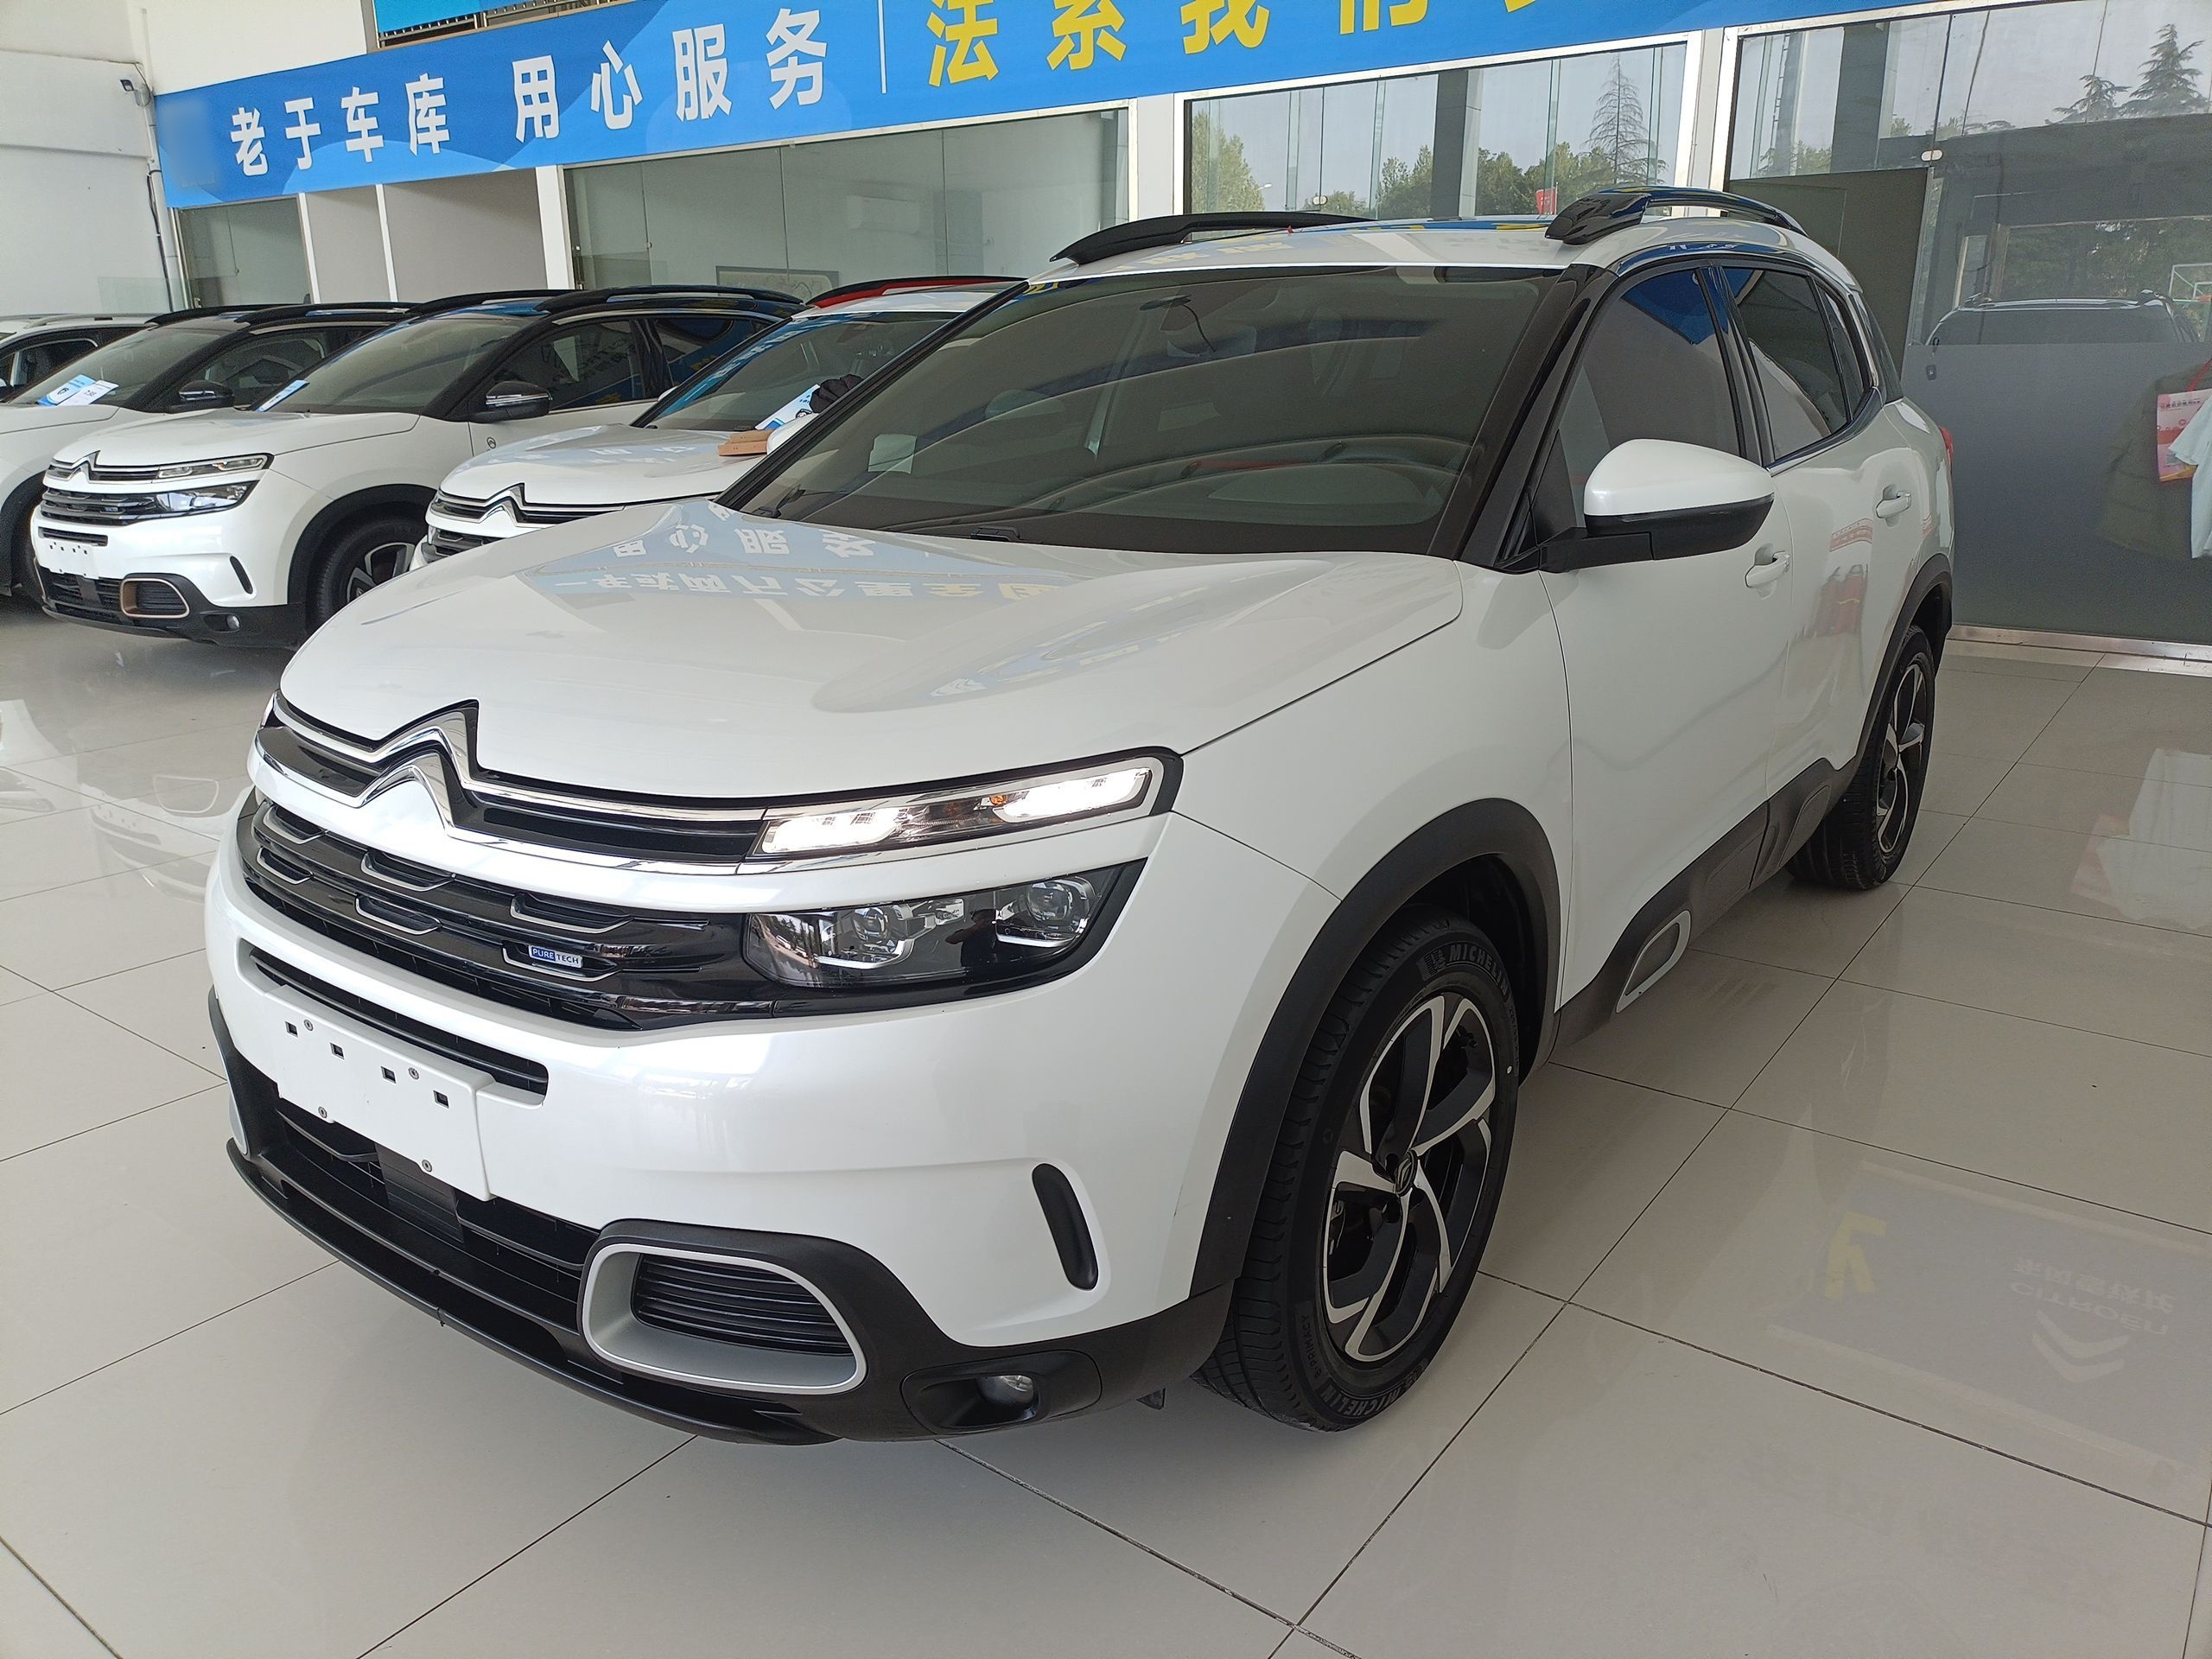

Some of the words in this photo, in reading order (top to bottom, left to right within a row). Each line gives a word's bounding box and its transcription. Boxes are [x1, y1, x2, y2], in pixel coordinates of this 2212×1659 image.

[229, 73, 450, 177] 老于车库
[512, 8, 828, 143] 用心服务
[532, 948, 555, 959] PURE
[557, 954, 579, 964] TECH
[1449, 944, 1509, 995] MICHELIN
[1322, 1384, 1401, 1416] MICHELIN
